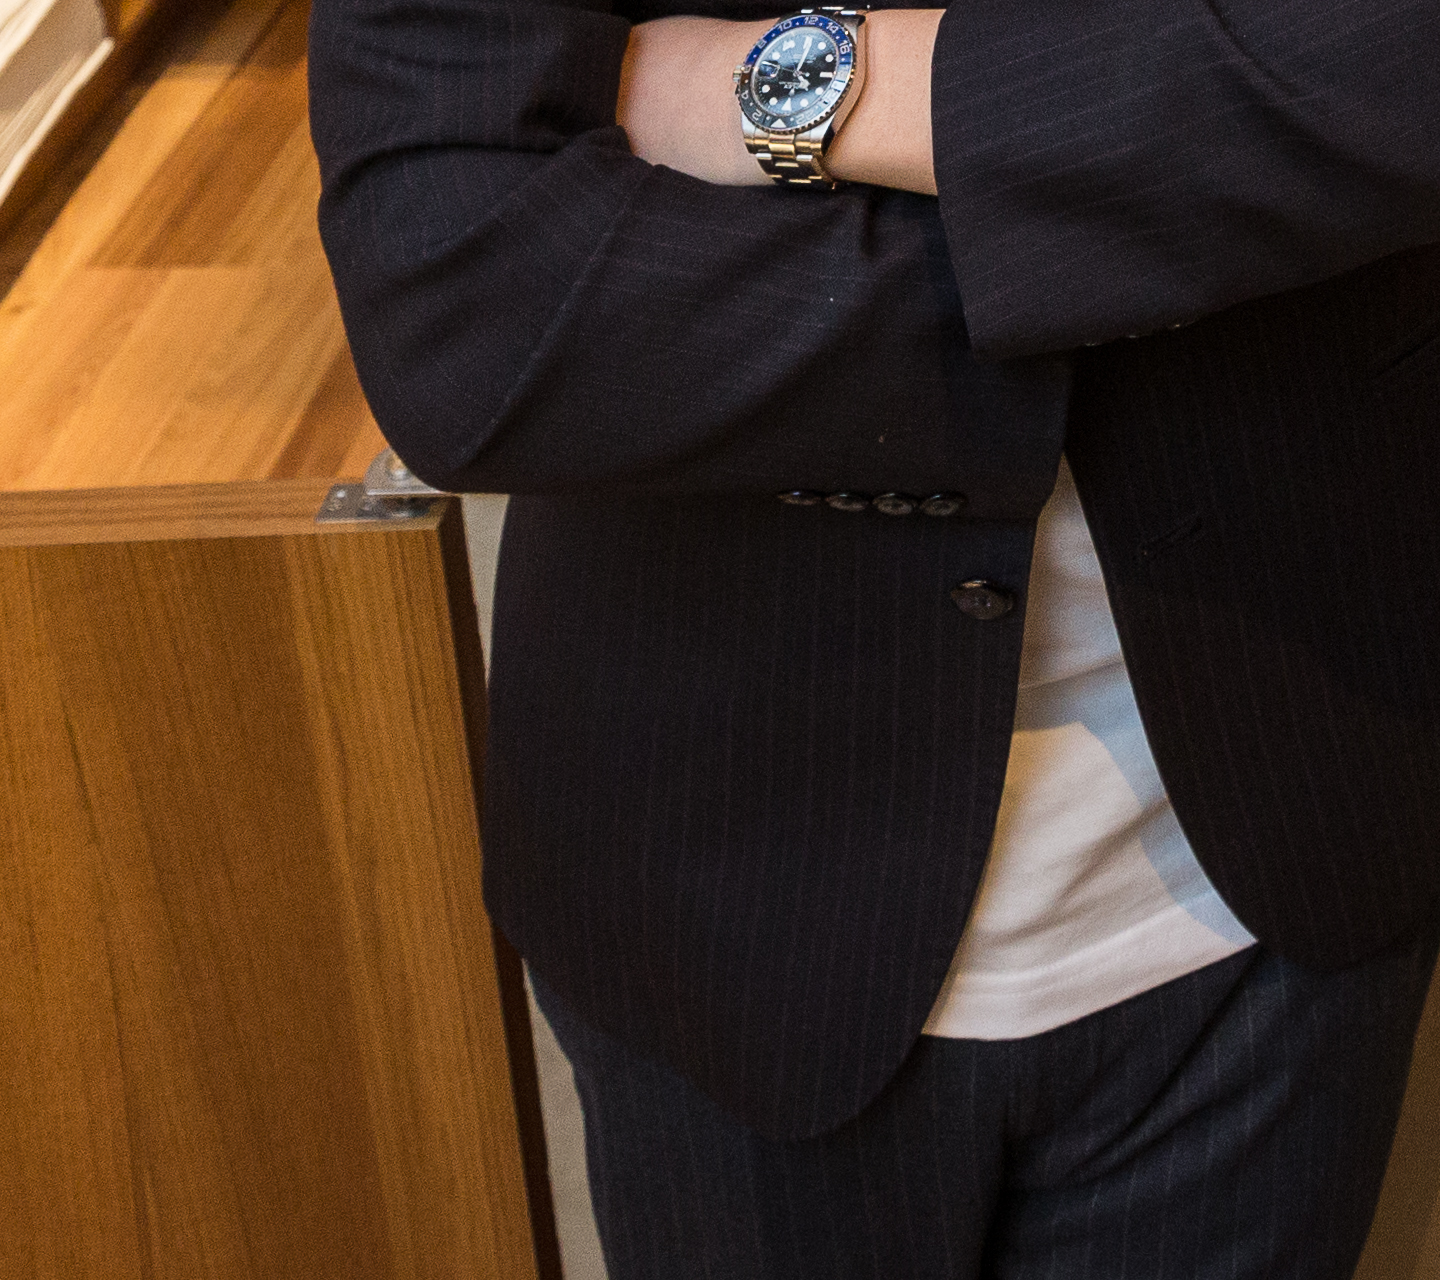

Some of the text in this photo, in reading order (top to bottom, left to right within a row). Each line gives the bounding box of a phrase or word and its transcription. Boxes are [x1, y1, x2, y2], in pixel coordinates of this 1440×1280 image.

[777, 20, 793, 33] 10
[803, 15, 819, 25] 12
[825, 21, 840, 34] 14
[838, 39, 851, 55] 16
